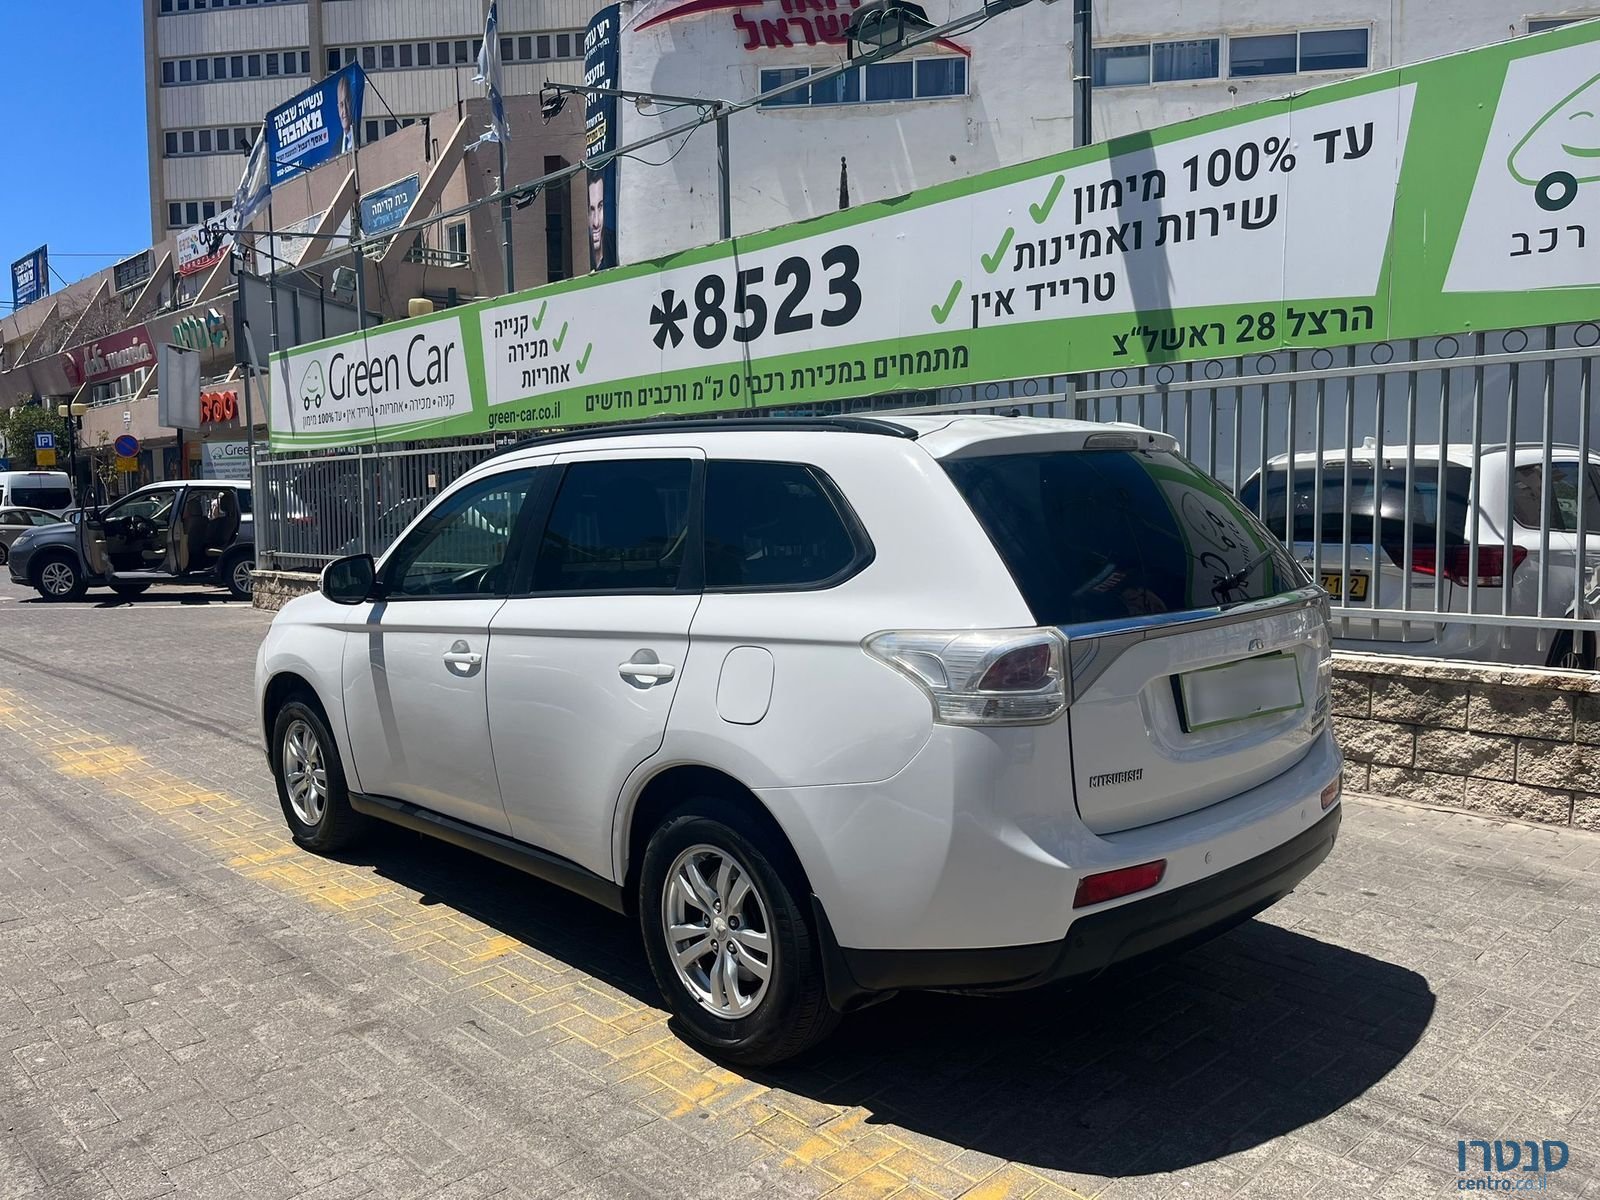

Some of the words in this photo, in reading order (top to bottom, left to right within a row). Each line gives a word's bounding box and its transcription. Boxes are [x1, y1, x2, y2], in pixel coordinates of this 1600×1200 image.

[733, 14, 850, 50] ישראל
[274, 105, 297, 130] שבאה
[277, 109, 323, 148] מאהבה!
[1313, 122, 1374, 164] עד
[1183, 136, 1296, 192] 100%
[372, 197, 393, 216] קדימה
[395, 192, 408, 207] בית
[1073, 169, 1166, 225] מימון
[1155, 193, 1278, 247] שירות
[1013, 220, 1142, 272] ואמינות
[1510, 225, 1585, 257] רכב
[1026, 271, 1116, 311] טרייד
[971, 287, 1015, 329] אין
[494, 315, 528, 339] קנייה
[1236, 311, 1276, 343] 28
[1286, 305, 1373, 337] הרצל
[508, 338, 548, 363] מכירה
[874, 345, 969, 379] מתמחים
[329, 352, 400, 401] Green
[407, 334, 455, 388] Car
[522, 363, 570, 388] אחריות
[791, 360, 866, 391] במכירת
[638, 383, 687, 407] ורכבים
[729, 374, 740, 397] 0
[745, 371, 784, 396] רכבי
[357, 406, 374, 418] טרייד
[380, 401, 404, 415] אחריות
[410, 397, 431, 412] מכירה
[437, 394, 455, 410] קניה
[585, 390, 633, 412] חדשים
[302, 415, 317, 430] מימון
[318, 412, 334, 424] 100%
[335, 411, 342, 422] עד
[346, 408, 356, 423] אין
[488, 401, 560, 429] green-car.co.il
[225, 444, 249, 456] Gree
[1089, 768, 1143, 788] MITSUBISHI
